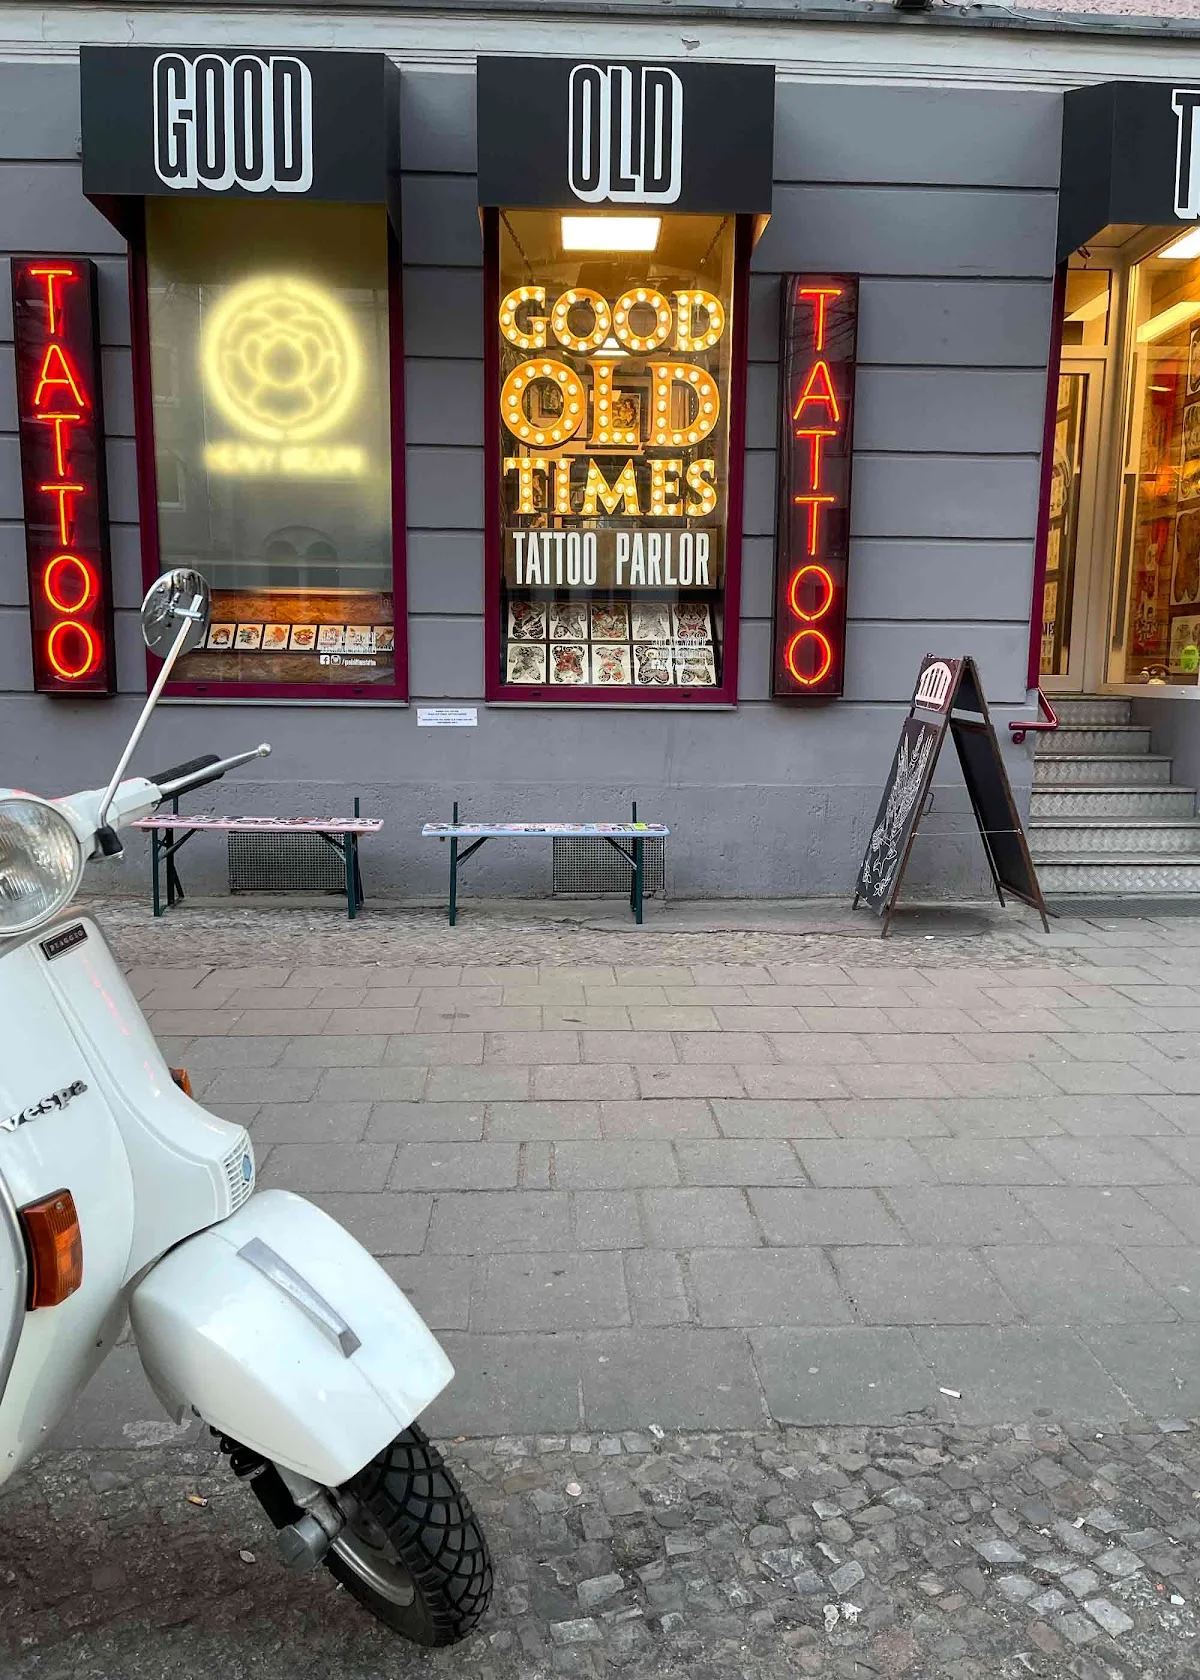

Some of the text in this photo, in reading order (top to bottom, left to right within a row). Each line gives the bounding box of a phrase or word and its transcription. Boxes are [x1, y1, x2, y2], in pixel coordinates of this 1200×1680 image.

[153, 53, 313, 192] GOOD
[568, 64, 683, 204] OLD
[499, 286, 725, 351] GOOD
[500, 359, 720, 447] OLD
[31, 269, 93, 678] TATTOO
[503, 457, 717, 516] TIMES
[788, 288, 842, 685] TATTOO
[513, 532, 709, 585] TATTOO PARLOR
[49, 930, 83, 951] PIAGGIO
